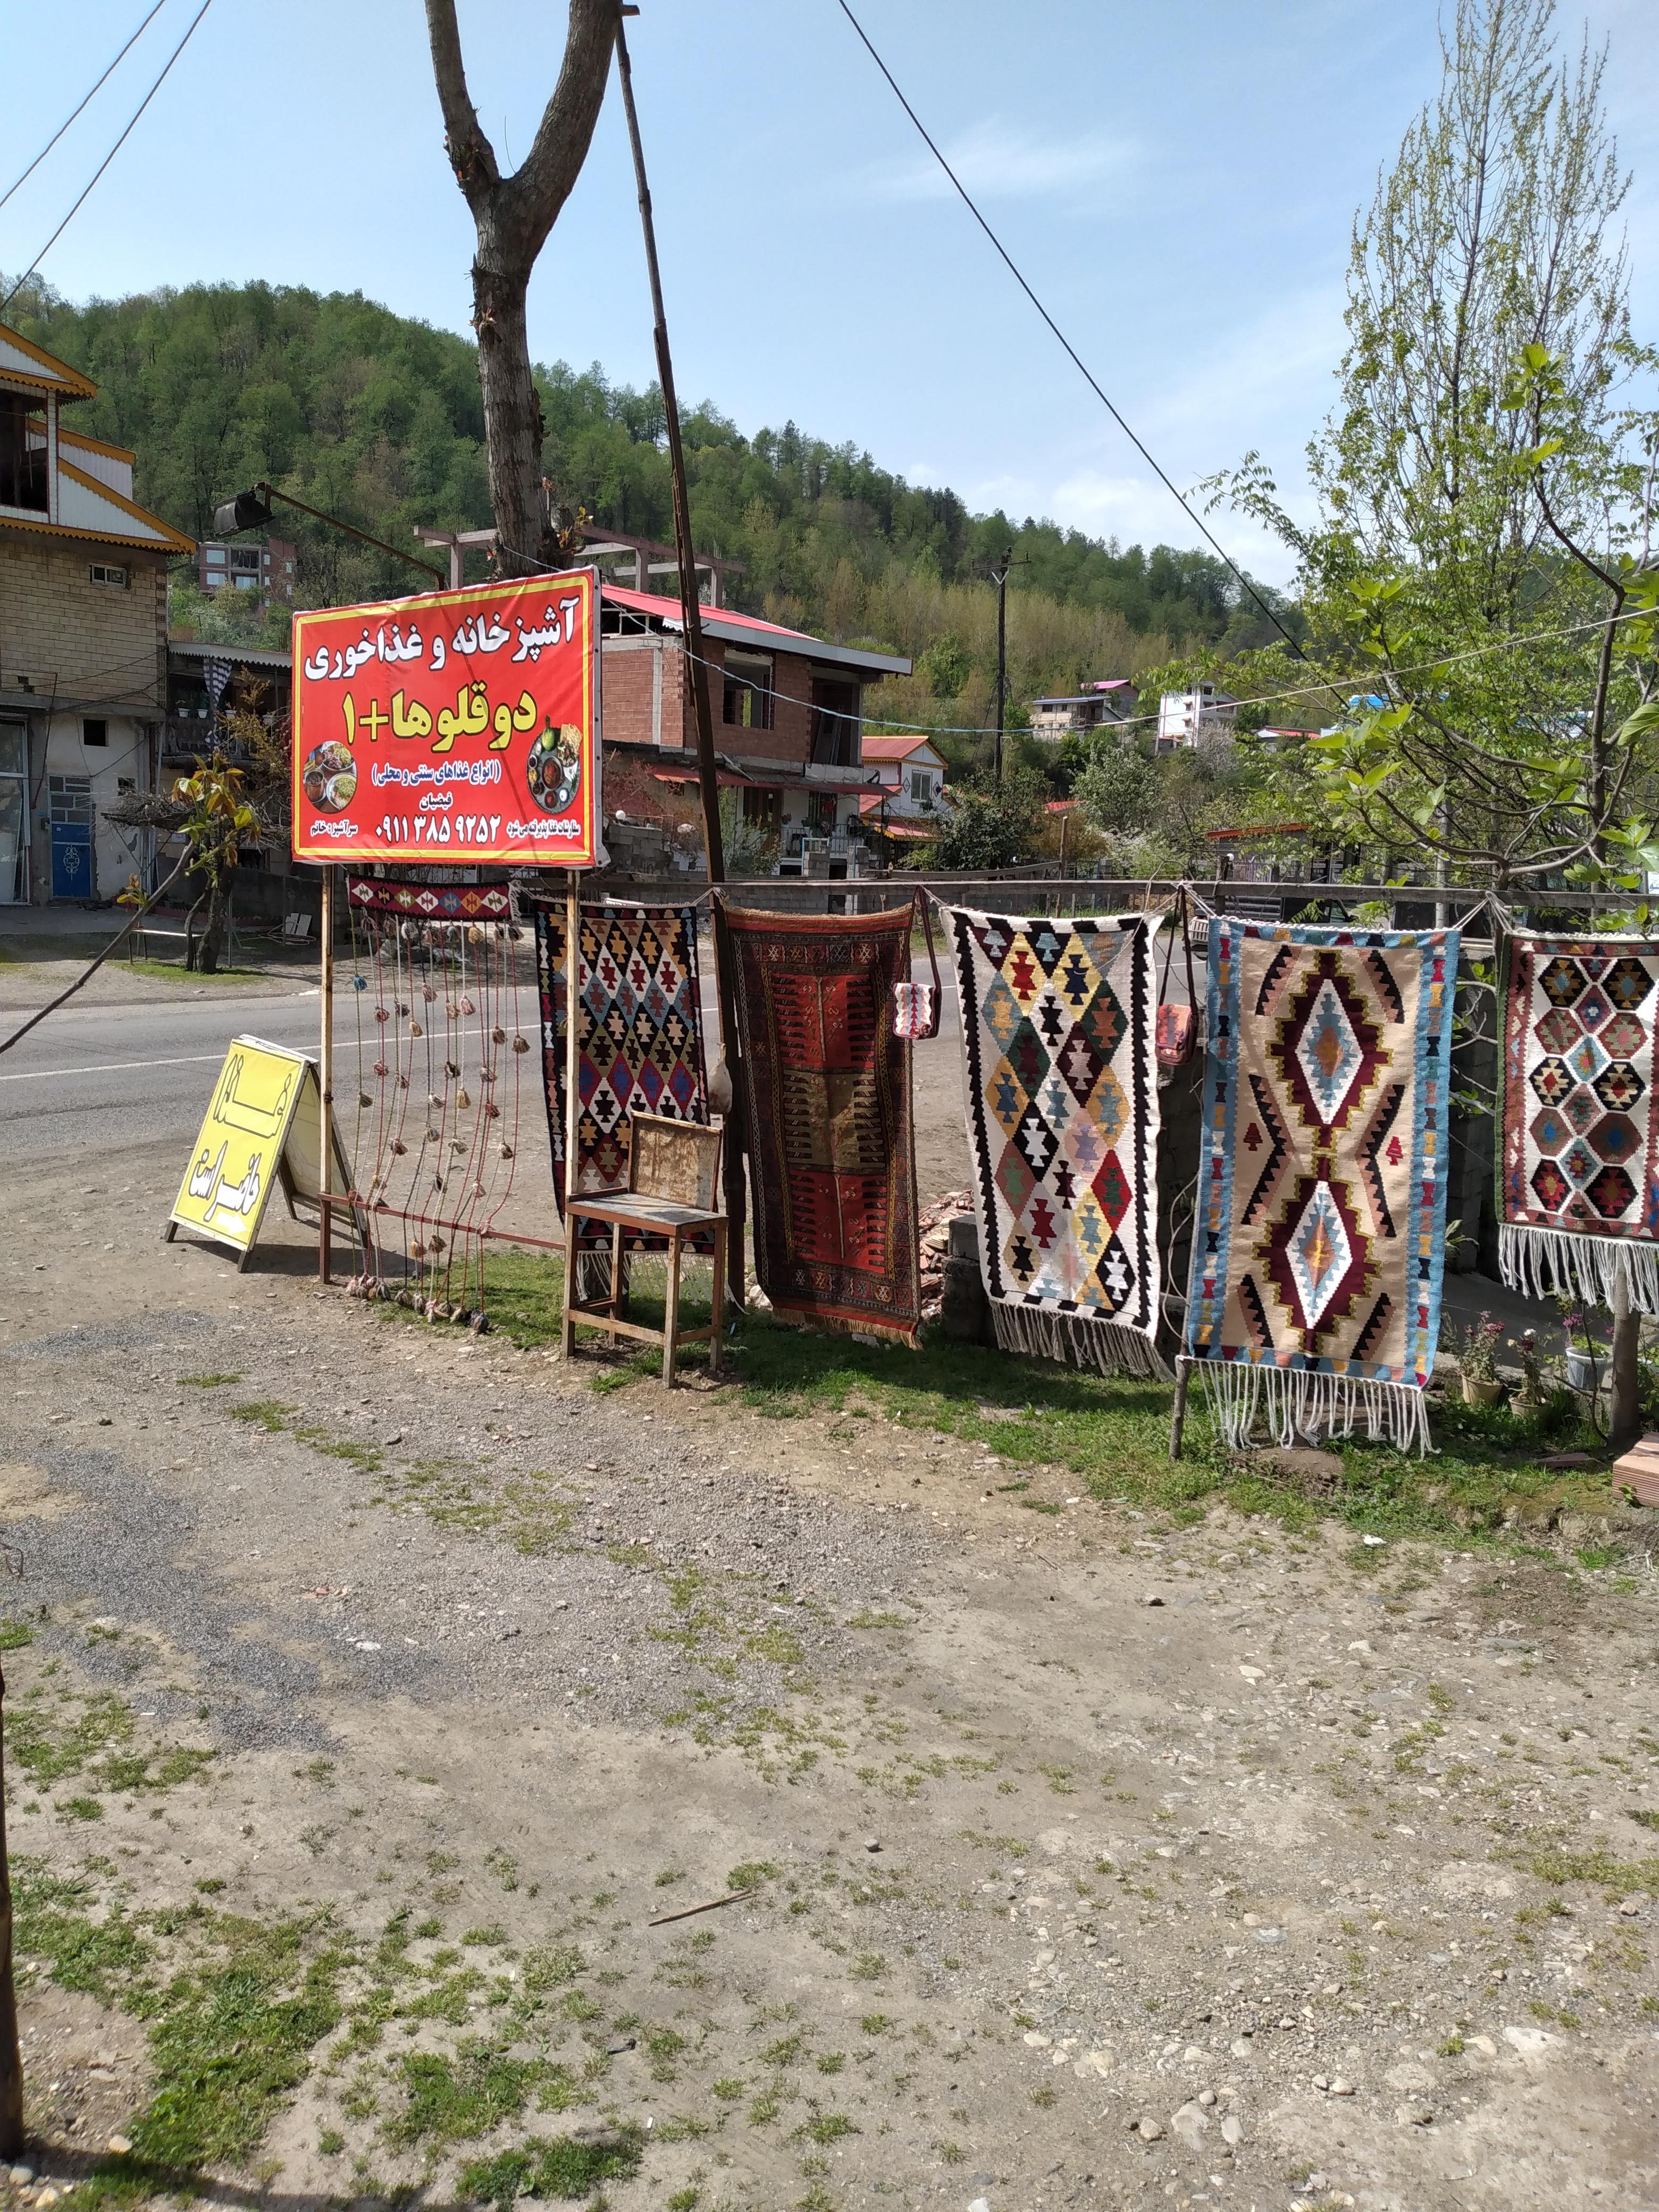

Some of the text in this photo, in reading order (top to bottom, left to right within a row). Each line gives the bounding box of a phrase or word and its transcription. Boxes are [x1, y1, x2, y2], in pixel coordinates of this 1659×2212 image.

[304, 623, 424, 680] غذاخوری
[429, 635, 446, 671] و
[402, 770, 408, 785] و
[410, 766, 433, 785] سنتی
[435, 761, 469, 784] غذاهای
[420, 792, 453, 810] فیضیان
[311, 821, 326, 836] خانم
[548, 820, 557, 833] غذا
